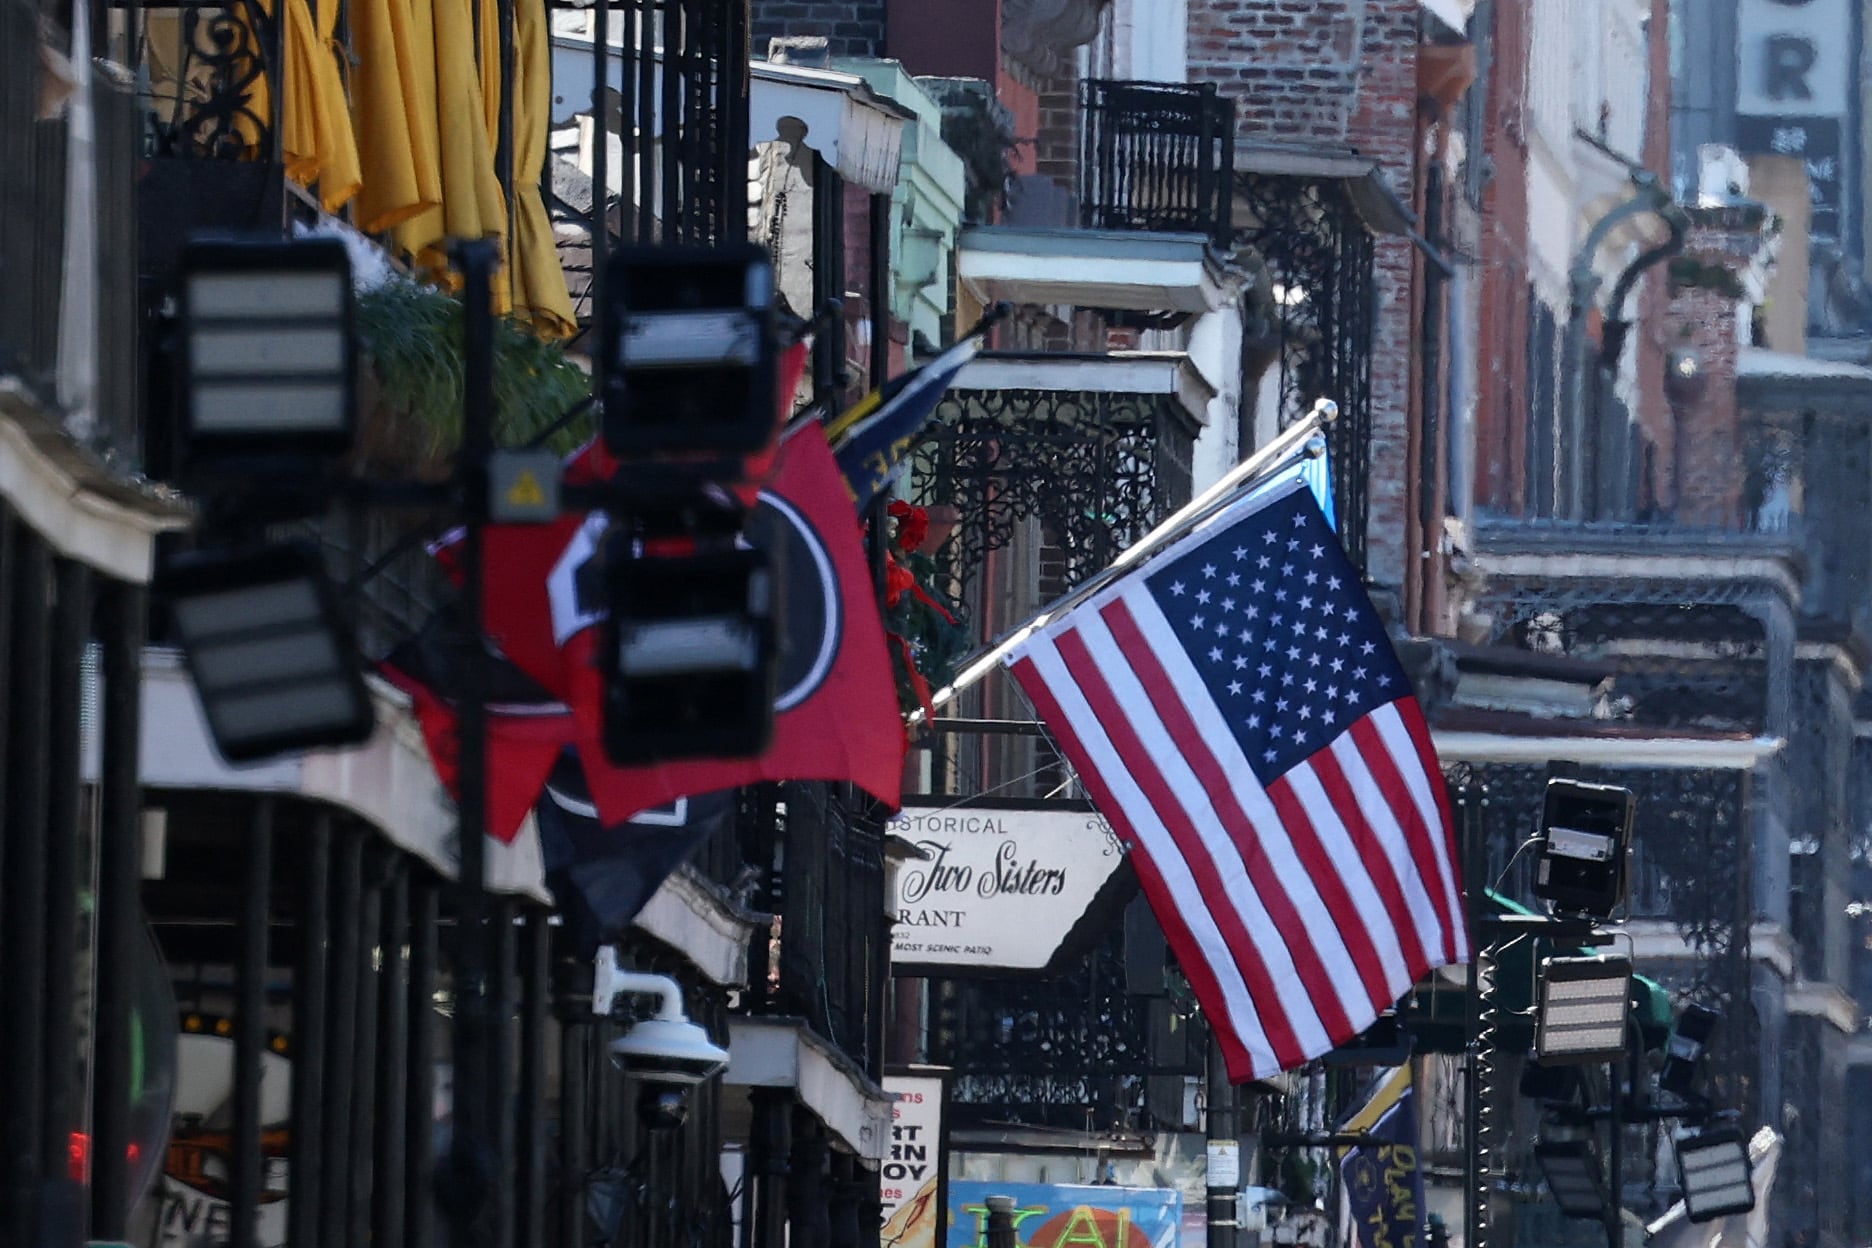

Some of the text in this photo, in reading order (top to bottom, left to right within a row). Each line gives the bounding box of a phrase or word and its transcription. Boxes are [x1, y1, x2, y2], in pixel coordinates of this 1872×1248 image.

[902, 840, 1066, 903] Two Sisters
[894, 942, 992, 955] MOST SCENIC PATIO
